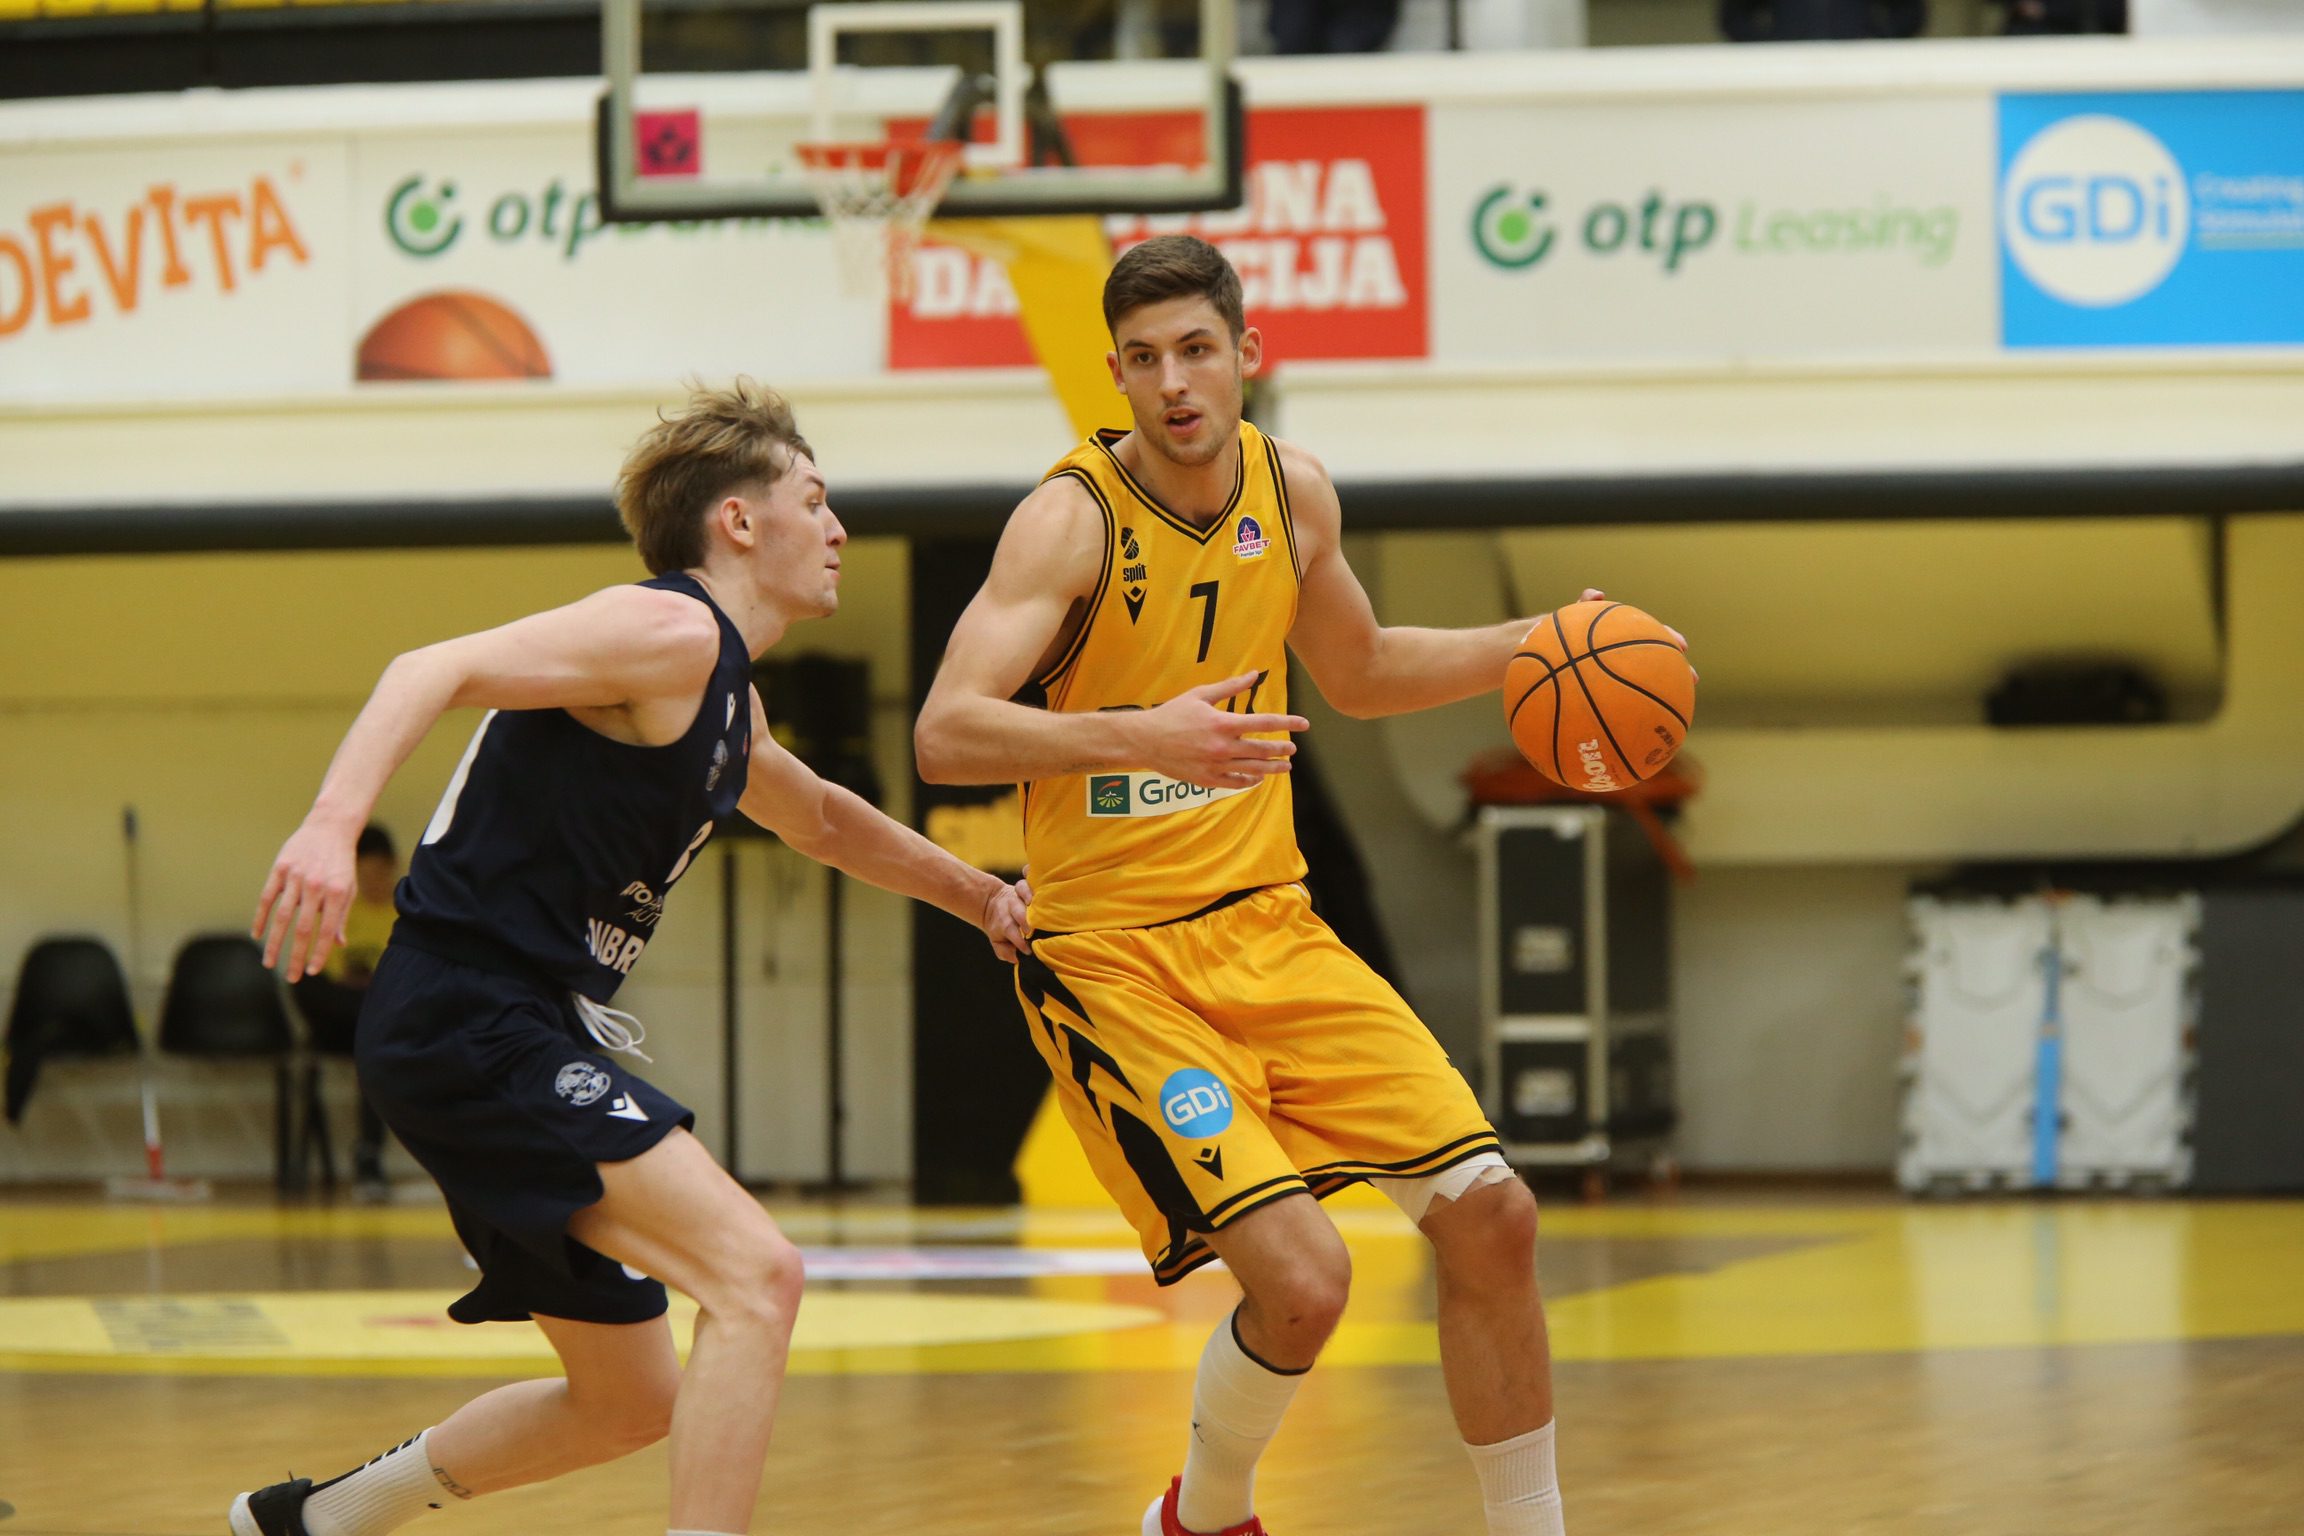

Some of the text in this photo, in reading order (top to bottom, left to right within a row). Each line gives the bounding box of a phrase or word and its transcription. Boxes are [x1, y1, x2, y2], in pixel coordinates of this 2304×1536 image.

[1582, 188, 1719, 274] otp
[1733, 192, 1961, 268] Leasing
[2018, 174, 2169, 243] GDi
[1123, 563, 1148, 583] split
[1233, 539, 1270, 553] FAVBET
[1165, 1082, 1230, 1126] GDi
